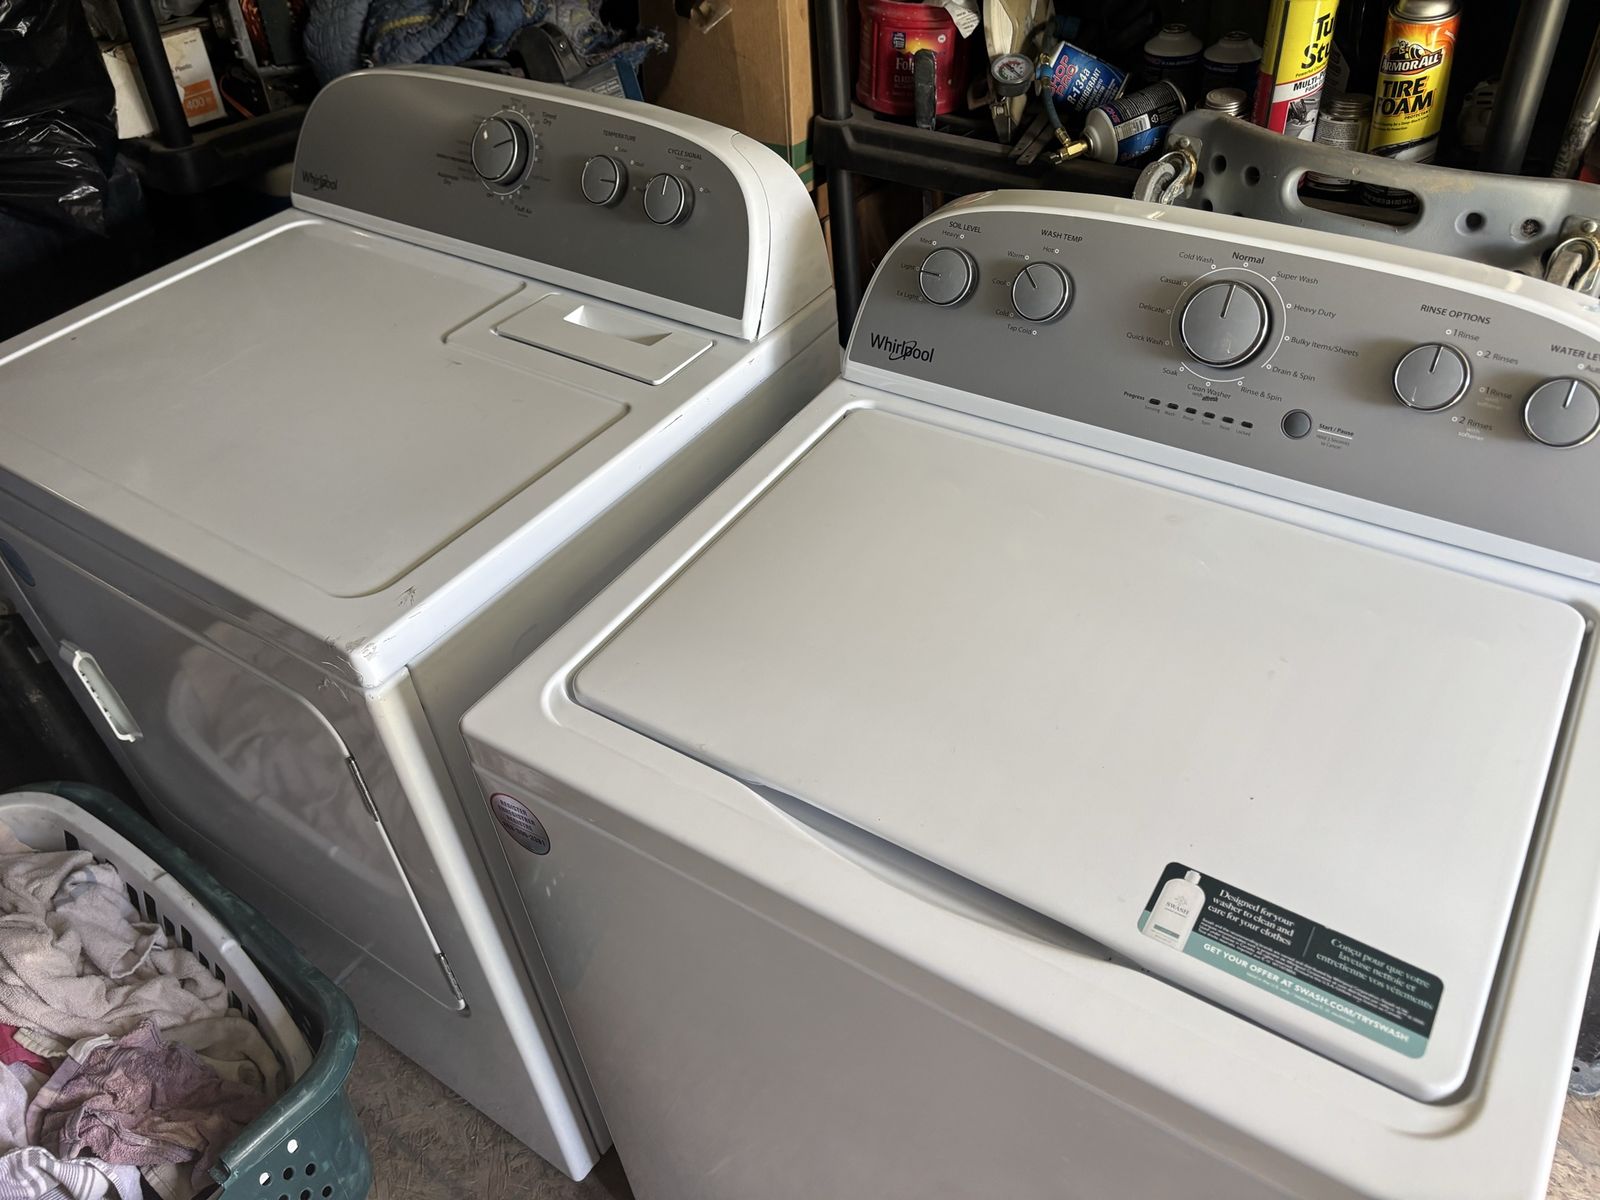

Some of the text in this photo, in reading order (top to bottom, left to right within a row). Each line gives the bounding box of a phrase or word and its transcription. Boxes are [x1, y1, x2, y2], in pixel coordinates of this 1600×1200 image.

[1067, 67, 1091, 105] R-134a
[1382, 75, 1429, 98] TIRE
[1375, 90, 1435, 116] FOAM
[602, 130, 636, 142] TEMPERATURE
[302, 170, 338, 191] Whirlpool
[942, 229, 960, 239] Heavy
[948, 221, 982, 234] SOIL LEVEL
[1040, 228, 1084, 243] WASH TEMP
[1179, 251, 1214, 265] Cold Wash
[1231, 251, 1265, 265] Normal
[1159, 275, 1183, 287] Casual
[1276, 270, 1319, 285] Super Wash
[1138, 302, 1167, 315] Delicate
[1293, 303, 1337, 320] Heavy Duty
[1420, 304, 1492, 325] RINSE OPTIONS
[1126, 331, 1165, 347] Quick Wash
[1458, 330, 1481, 342] Rinse
[870, 332, 935, 363] Whirlpool
[1291, 336, 1360, 358] Bulky Items/Sheets
[1550, 343, 1586, 358] WATER
[1484, 350, 1519, 365] 2 Rinses
[1162, 367, 1179, 377] Soak
[1272, 366, 1317, 383] Drain & Spin
[1123, 390, 1146, 401] Progress
[1187, 383, 1232, 400] Clean Washer
[1240, 386, 1284, 403] Rinse & Spin
[1490, 389, 1513, 400] Rinse
[1319, 423, 1333, 432] Start
[1337, 427, 1354, 437] Pause
[1459, 416, 1494, 431] 2 Rinses
[1166, 901, 1190, 916] SWASH
[1219, 889, 1295, 928] Designed for your
[1207, 904, 1292, 946] care for your clothes
[1213, 897, 1295, 938] washer to clean and
[1316, 952, 1368, 981] entretienne
[1368, 976, 1386, 988] vos
[1330, 938, 1431, 989] Conçu pour que votre
[1337, 950, 1417, 993] laveuse nettoie et
[1203, 943, 1410, 1042] GET YOUR OFFER AT SWASH.COM/TRYSWASH
